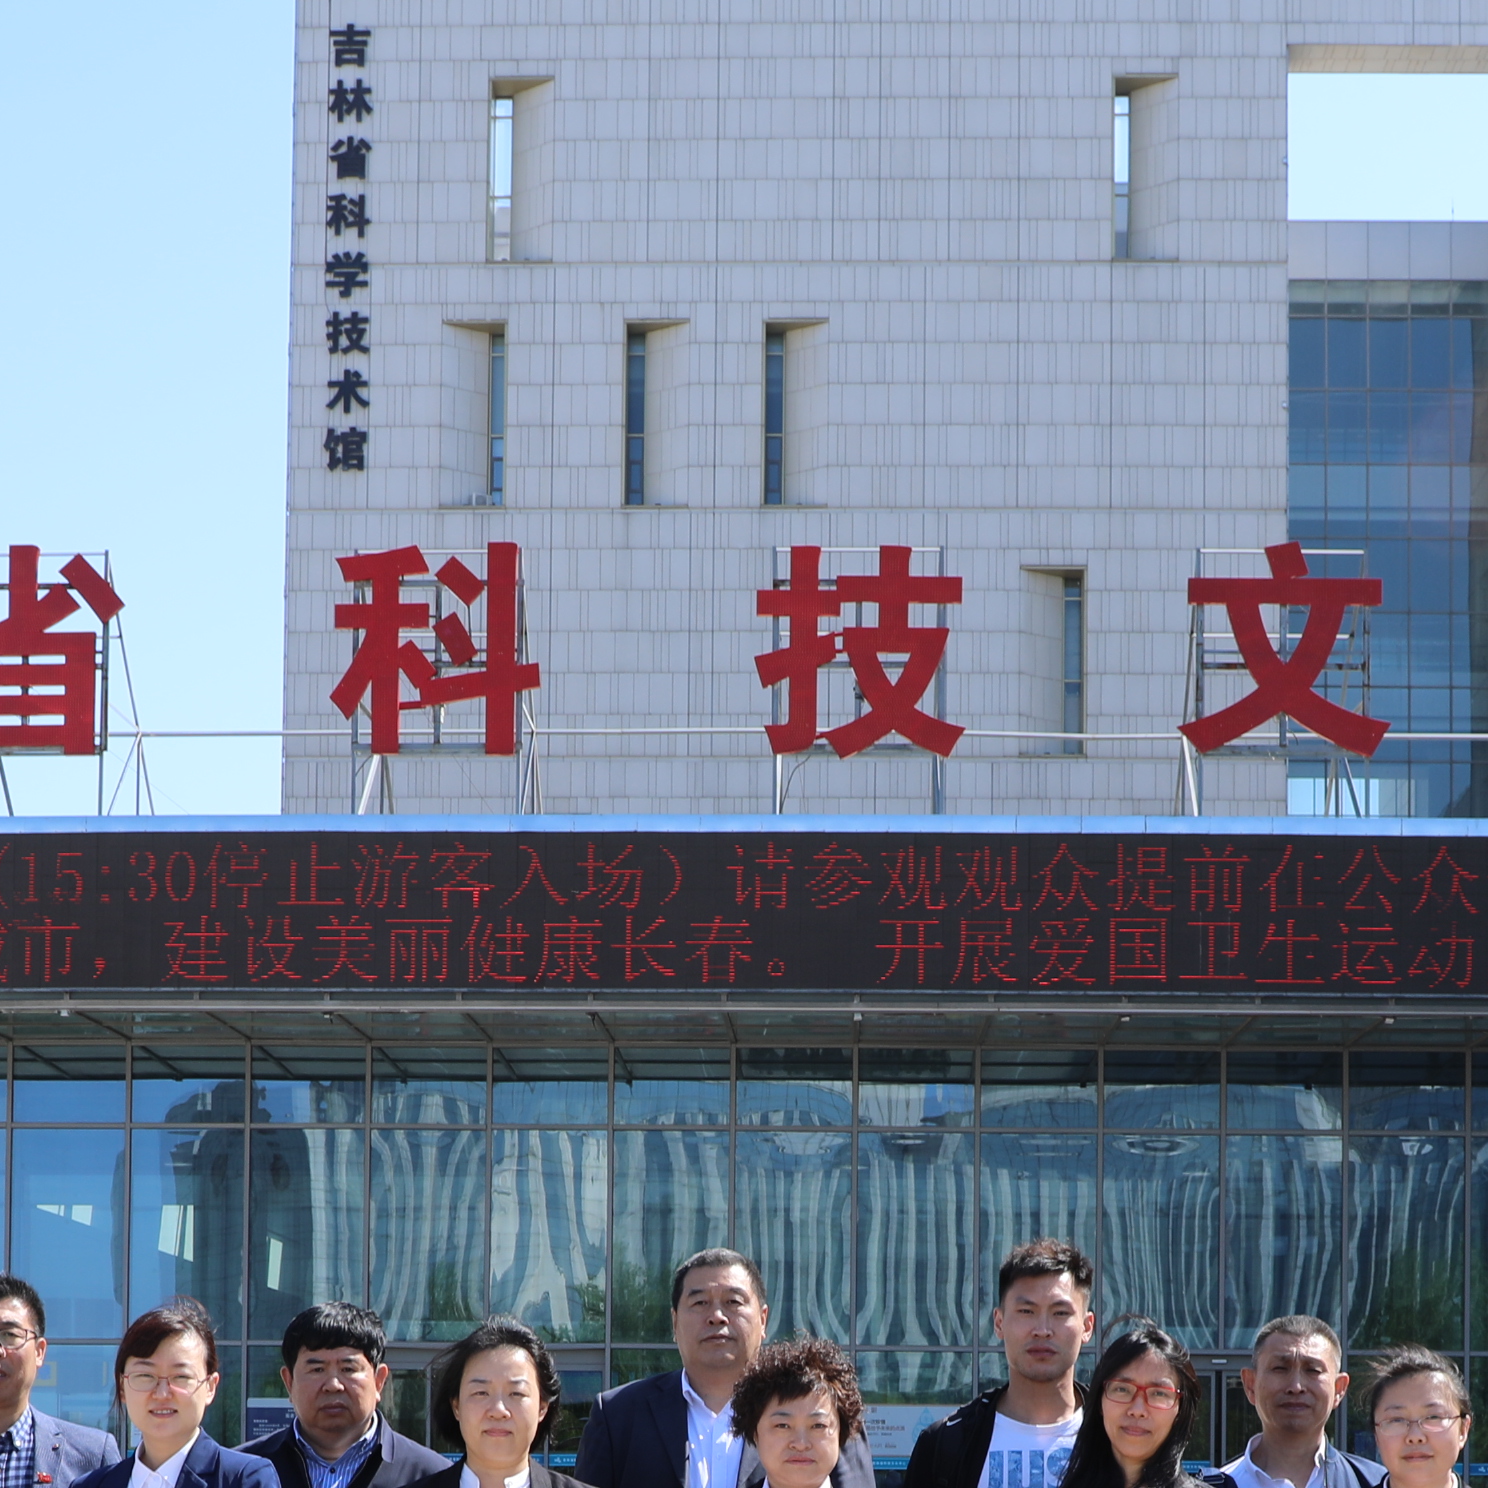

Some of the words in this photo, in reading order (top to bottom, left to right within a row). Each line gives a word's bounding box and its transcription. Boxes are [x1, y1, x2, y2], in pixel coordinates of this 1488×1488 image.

[324, 24, 373, 472] 吉林省科学技术馆
